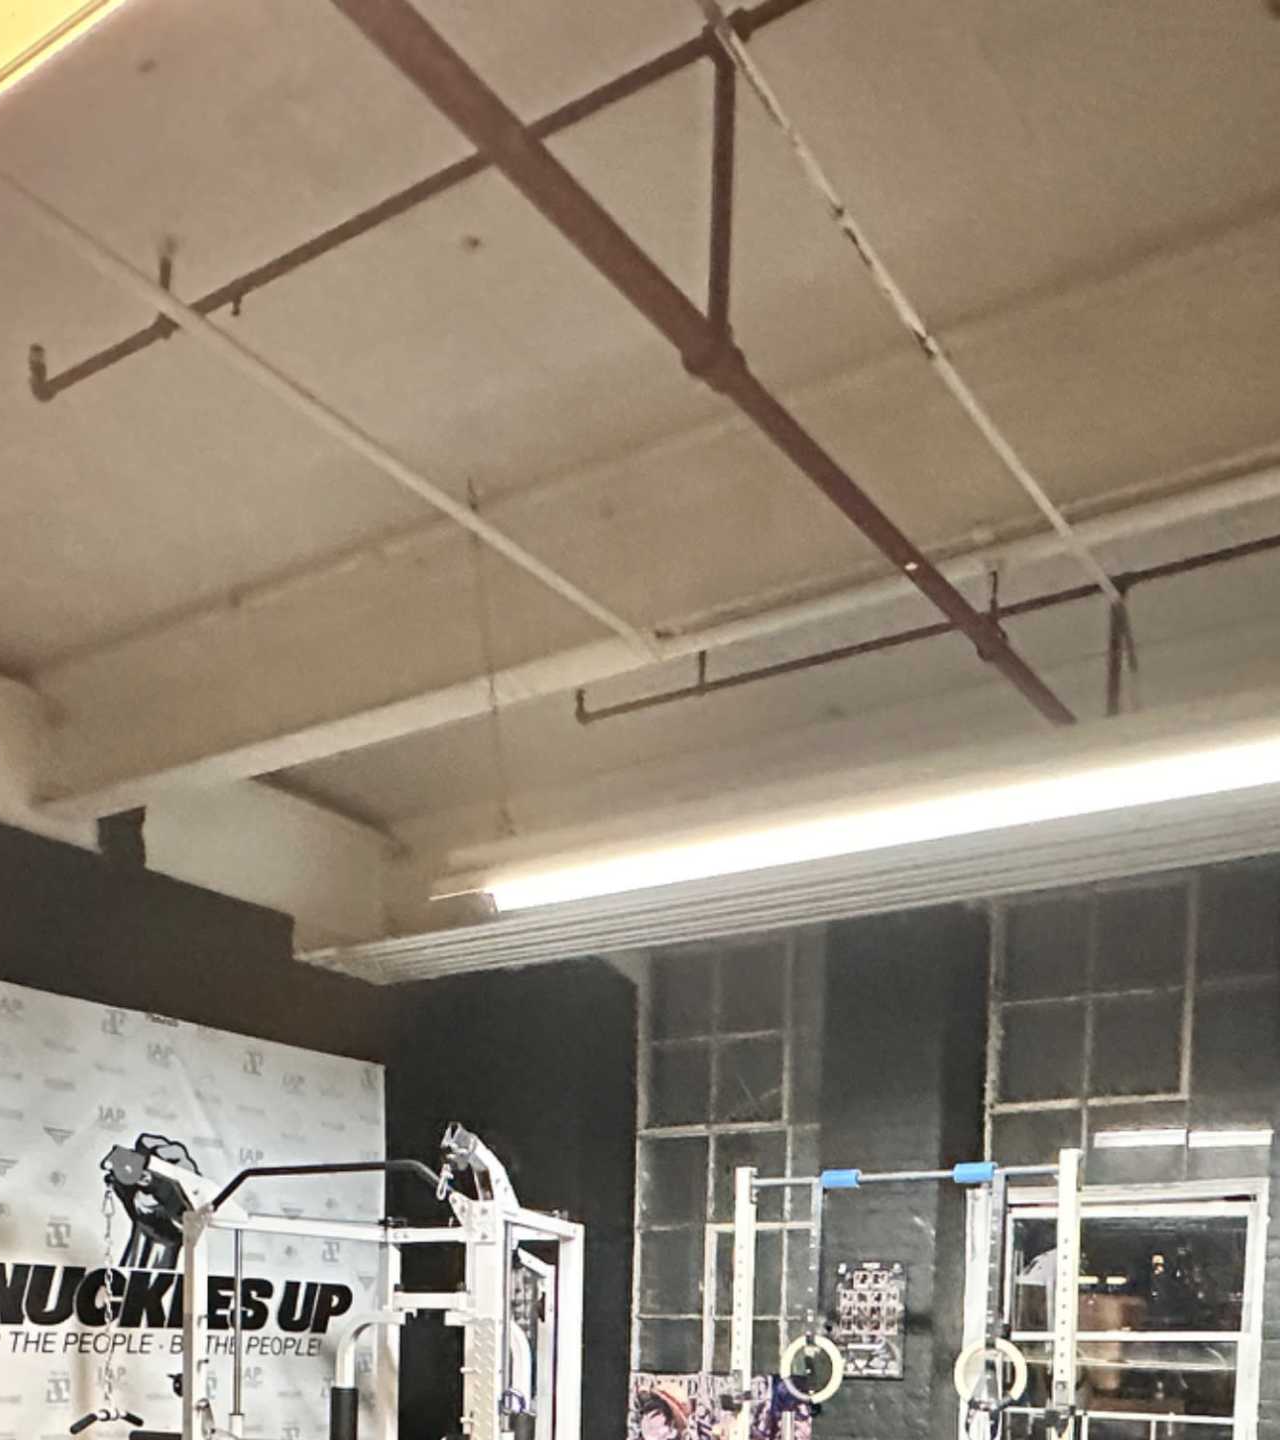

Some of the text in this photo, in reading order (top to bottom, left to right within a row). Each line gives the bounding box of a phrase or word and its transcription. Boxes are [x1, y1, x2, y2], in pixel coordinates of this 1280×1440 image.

[277, 1280, 353, 1334] UP
[9, 1331, 57, 1353] THE
[63, 1332, 154, 1354] PEOPLE
